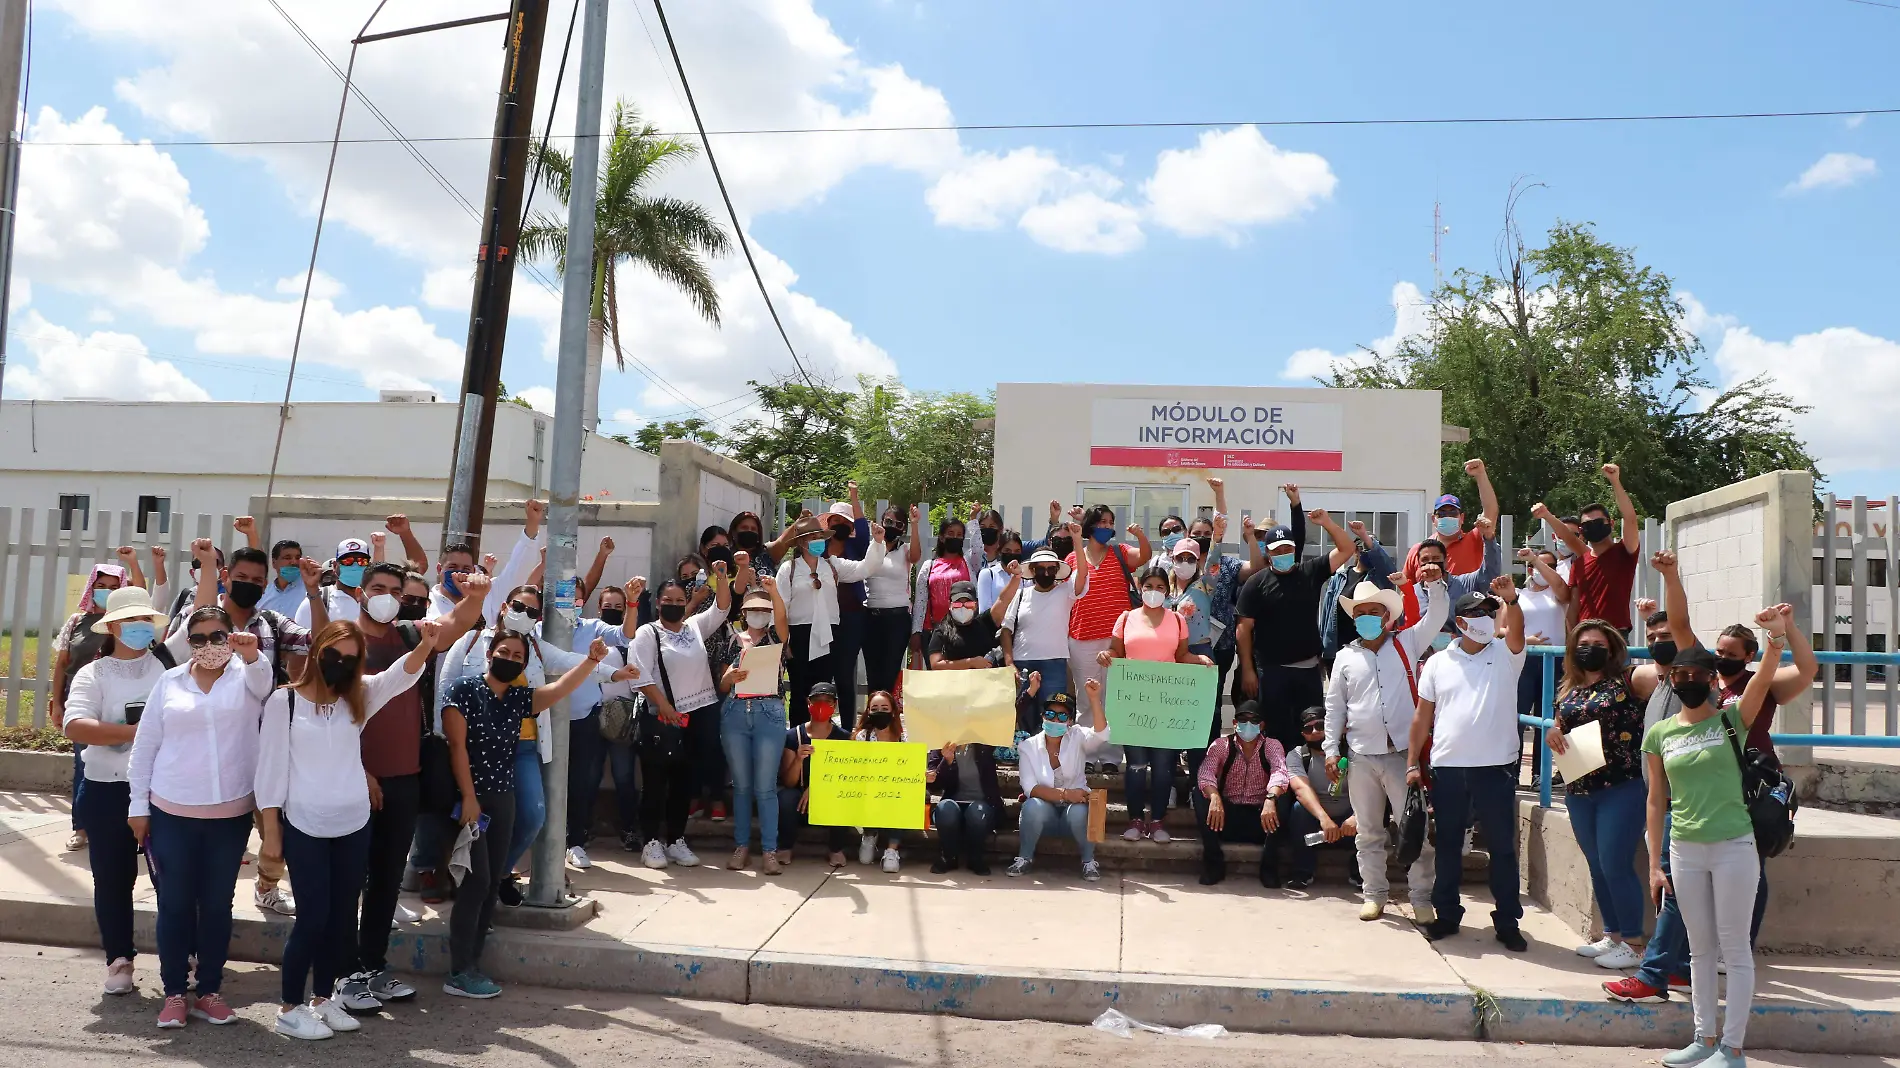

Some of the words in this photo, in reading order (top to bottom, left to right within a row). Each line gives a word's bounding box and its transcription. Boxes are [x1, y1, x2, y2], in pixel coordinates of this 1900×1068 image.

[1151, 402, 1246, 423] MÓDULO
[1254, 407, 1283, 424] DE
[1139, 425, 1294, 445] INFORMACIÓN
[1117, 664, 1196, 687] TRANSPARENCIA
[1117, 689, 1131, 701] EN
[1139, 692, 1153, 702] EL
[1160, 691, 1200, 707] PROCESO
[823, 750, 888, 765] TRANSPARENCIA
[896, 758, 908, 766] EN
[838, 774, 875, 782] PROCESO
[878, 775, 890, 783] DE
